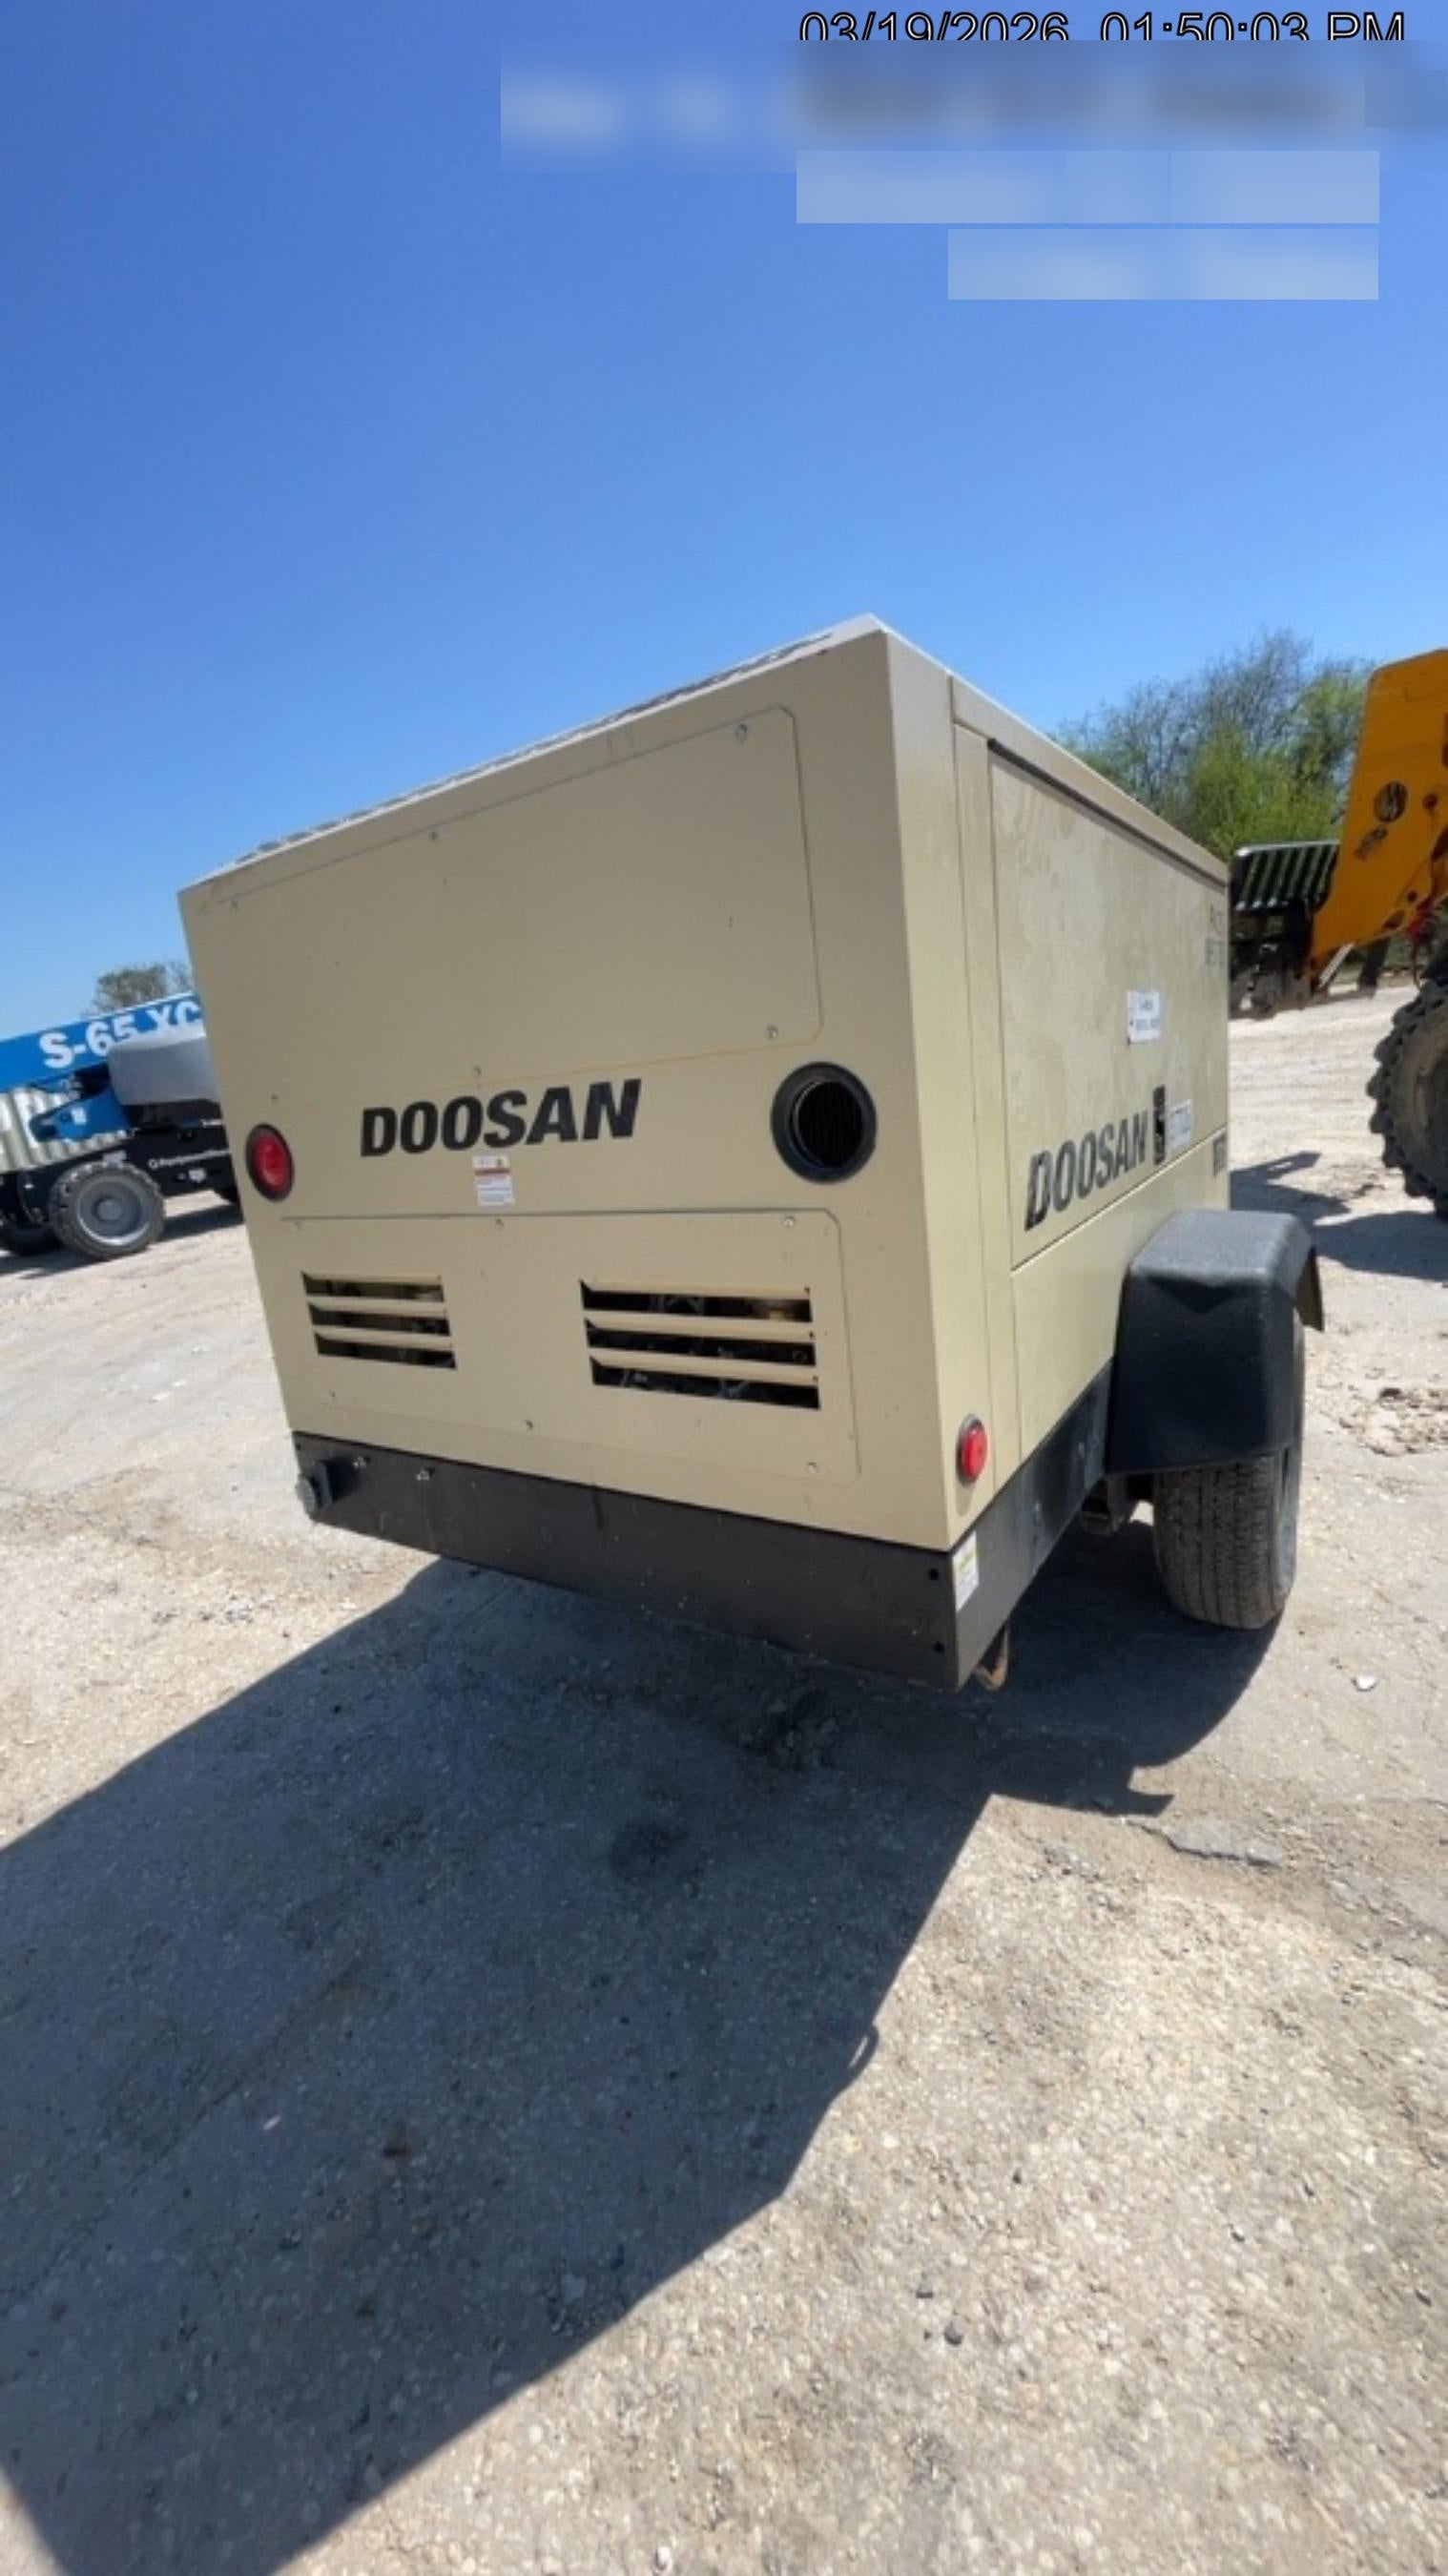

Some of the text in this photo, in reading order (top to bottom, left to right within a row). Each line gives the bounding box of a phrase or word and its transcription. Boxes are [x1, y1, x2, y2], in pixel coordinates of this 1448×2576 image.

[39, 1014, 137, 1069] S-65
[361, 1078, 641, 1156] DOOSAN
[1024, 1110, 1148, 1232] DOOSAN
